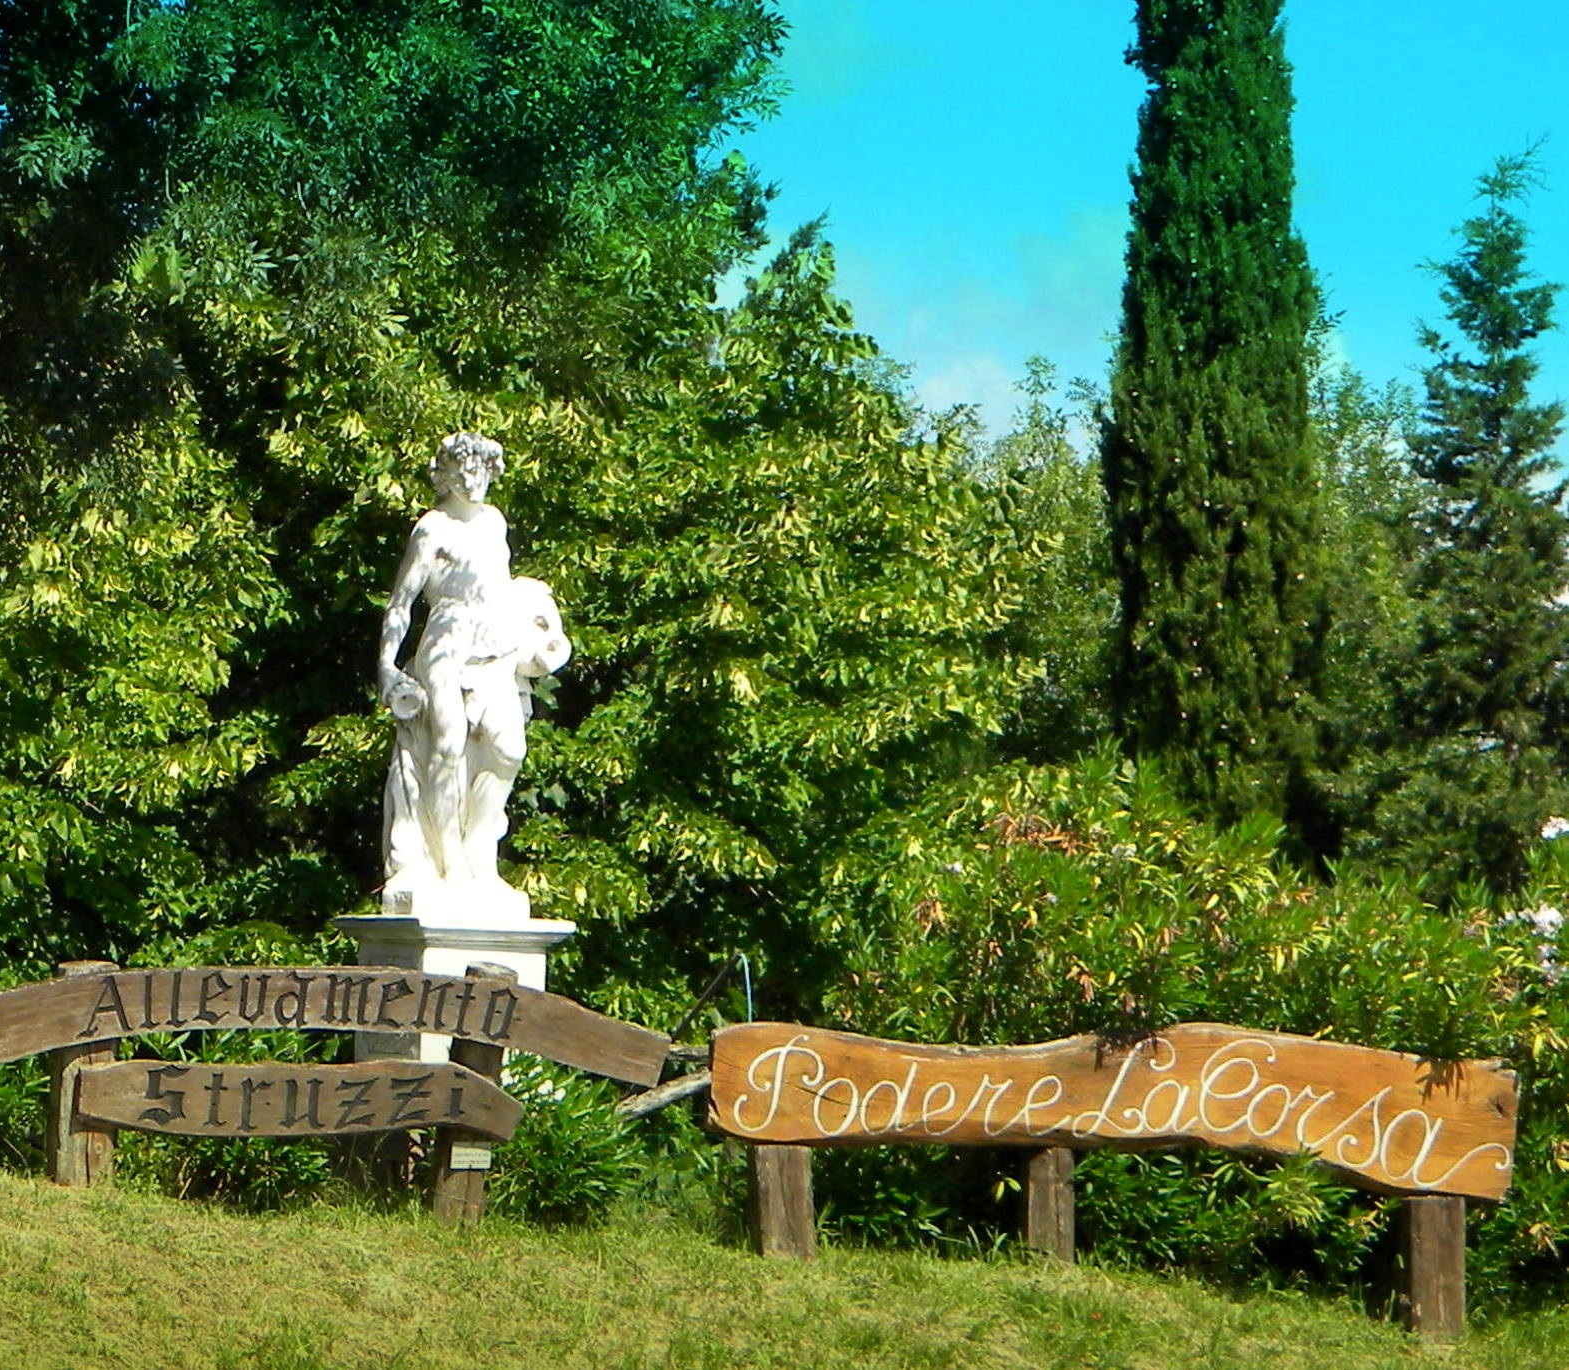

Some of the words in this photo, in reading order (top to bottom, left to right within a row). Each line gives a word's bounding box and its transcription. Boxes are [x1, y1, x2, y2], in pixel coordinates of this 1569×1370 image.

[76, 969, 520, 1041] Allevamento
[137, 1066, 471, 1132] Struzzi
[733, 1034, 1073, 1137] Podere
